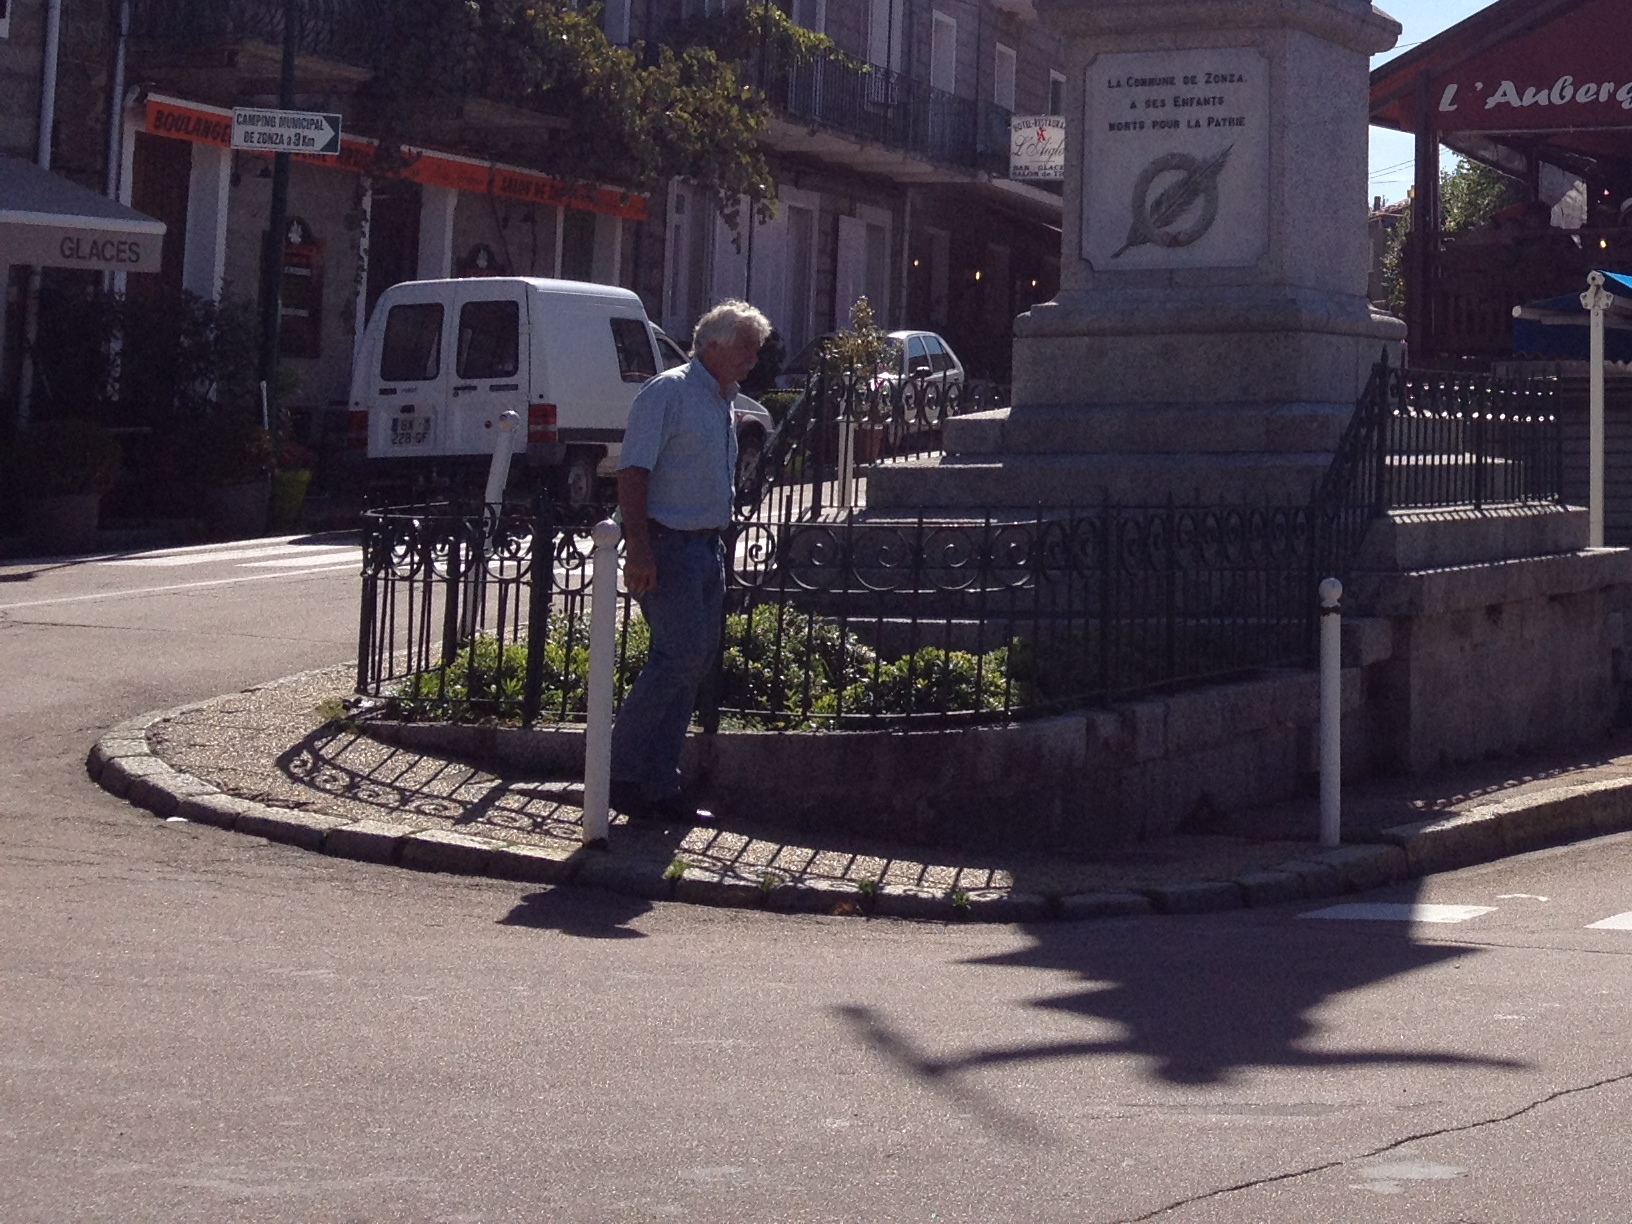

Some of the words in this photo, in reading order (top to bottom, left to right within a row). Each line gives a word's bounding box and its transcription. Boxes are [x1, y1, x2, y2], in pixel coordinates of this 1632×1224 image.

[1107, 79, 1122, 89] LA
[1183, 75, 1198, 85] DE
[1144, 97, 1167, 108] SES
[1173, 95, 1225, 108] ENFANTS
[236, 113, 276, 128] CAMPING
[279, 115, 324, 131] MUNICIPAL
[1108, 120, 1146, 132] MORTS
[1152, 119, 1181, 130] POUR
[1187, 118, 1202, 129] LA
[1207, 116, 1246, 128] PATRIE
[244, 131, 255, 143] DE
[256, 132, 285, 145] ZONZA
[302, 135, 315, 148] Km
[60, 236, 141, 263] GLACES
